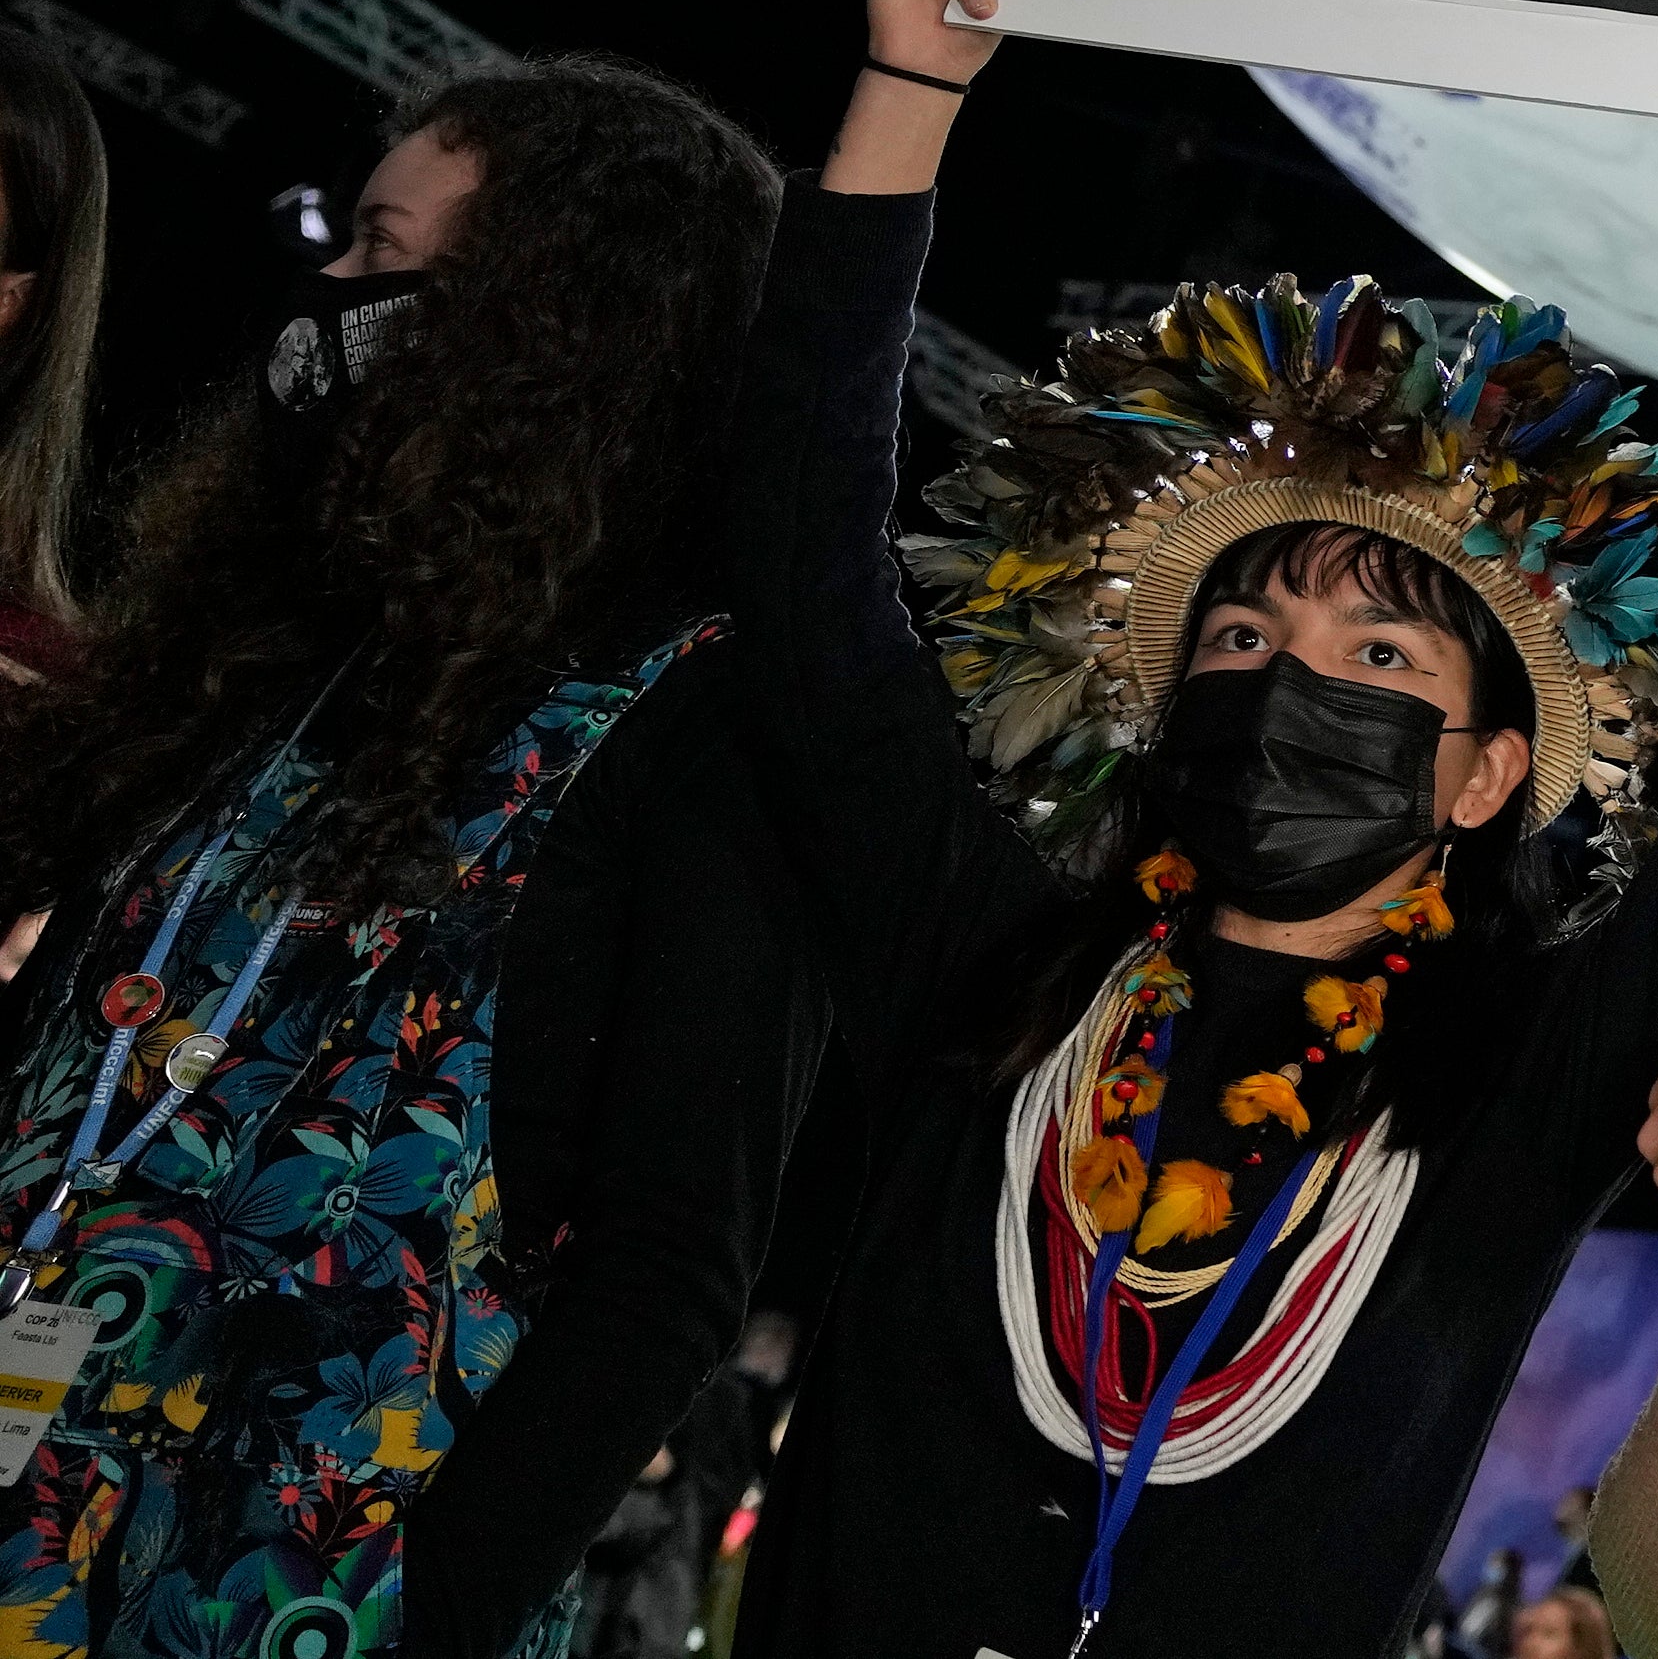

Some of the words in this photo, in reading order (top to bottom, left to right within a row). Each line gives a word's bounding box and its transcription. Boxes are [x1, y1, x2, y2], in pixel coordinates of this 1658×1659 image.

[341, 308, 358, 329] UN
[91, 1028, 130, 1107] nfccc.int
[25, 1314, 47, 1326] COP
[46, 1318, 60, 1328] 26
[0, 1385, 43, 1403] ERVER
[2, 1420, 31, 1436] Lima
